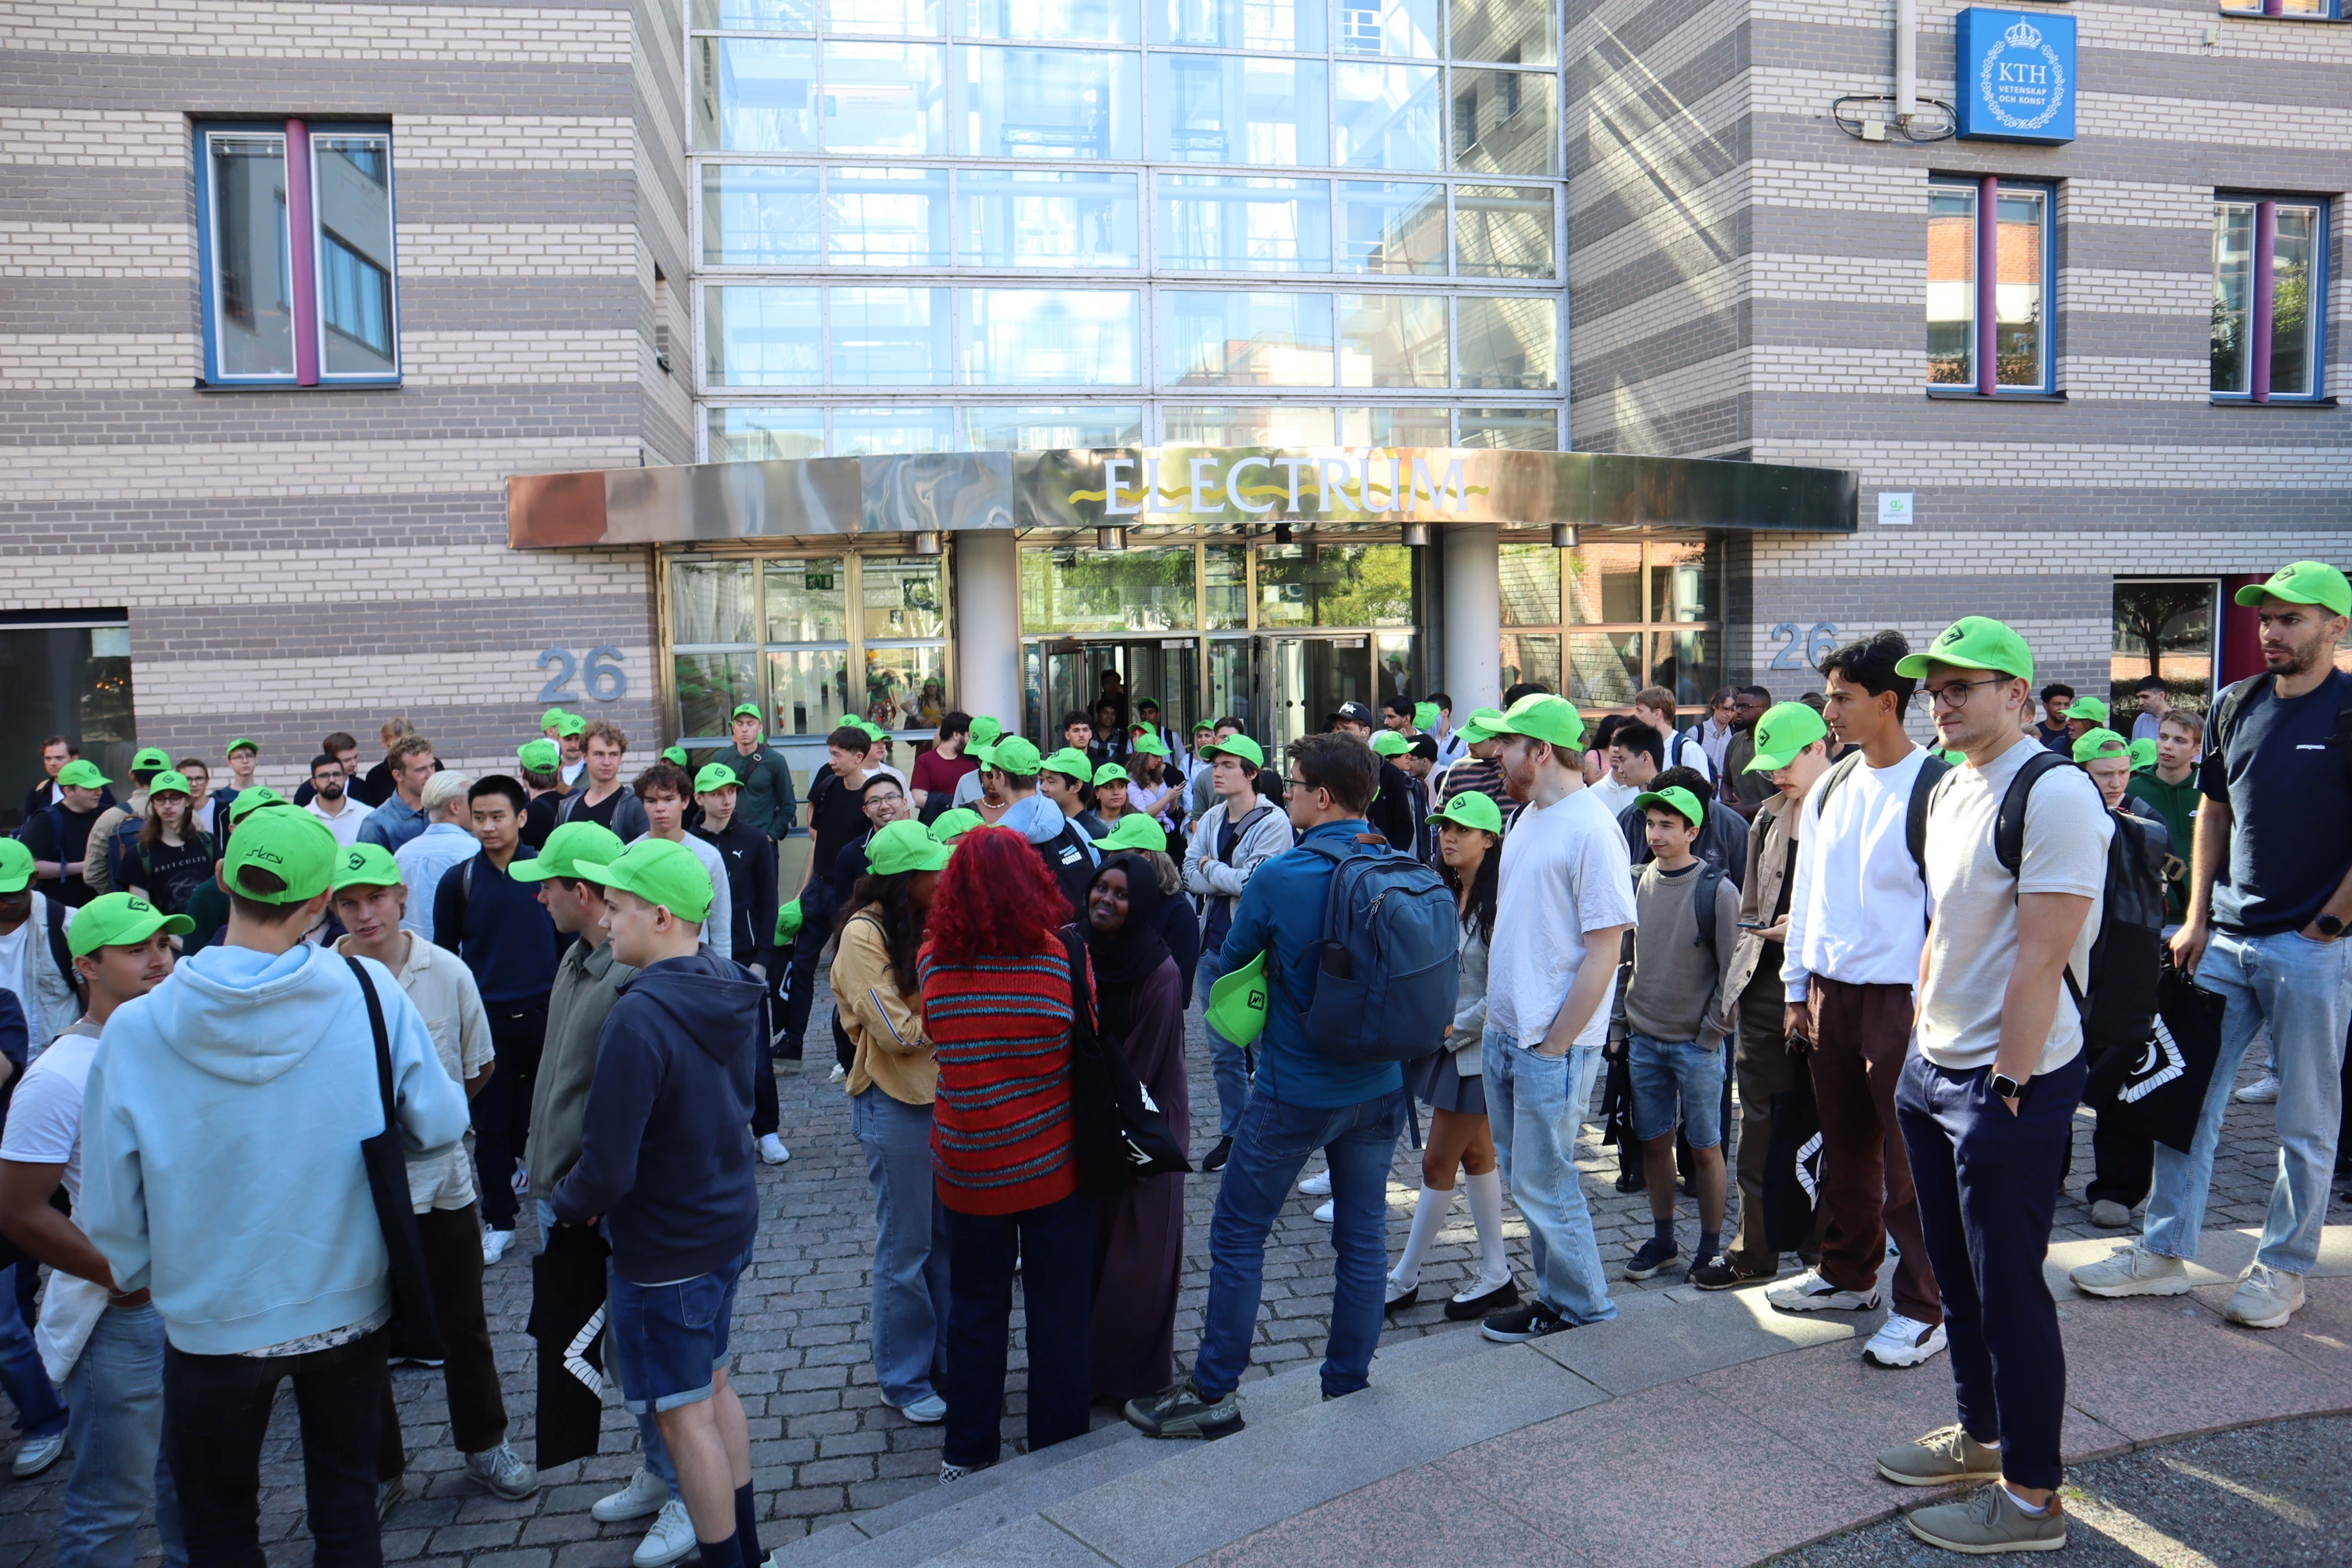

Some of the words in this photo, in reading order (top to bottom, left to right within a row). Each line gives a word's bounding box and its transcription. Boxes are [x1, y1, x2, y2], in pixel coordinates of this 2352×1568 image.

[1999, 62, 2047, 84] KTH
[1999, 85, 2047, 95] VETENSKAP
[2018, 96, 2046, 105] KONST
[1103, 457, 1468, 515] ELECTRUM
[537, 646, 627, 703] 26
[154, 862, 176, 873] RBIT
[179, 856, 207, 866] CULTU
[1212, 1404, 1235, 1420] ecc
